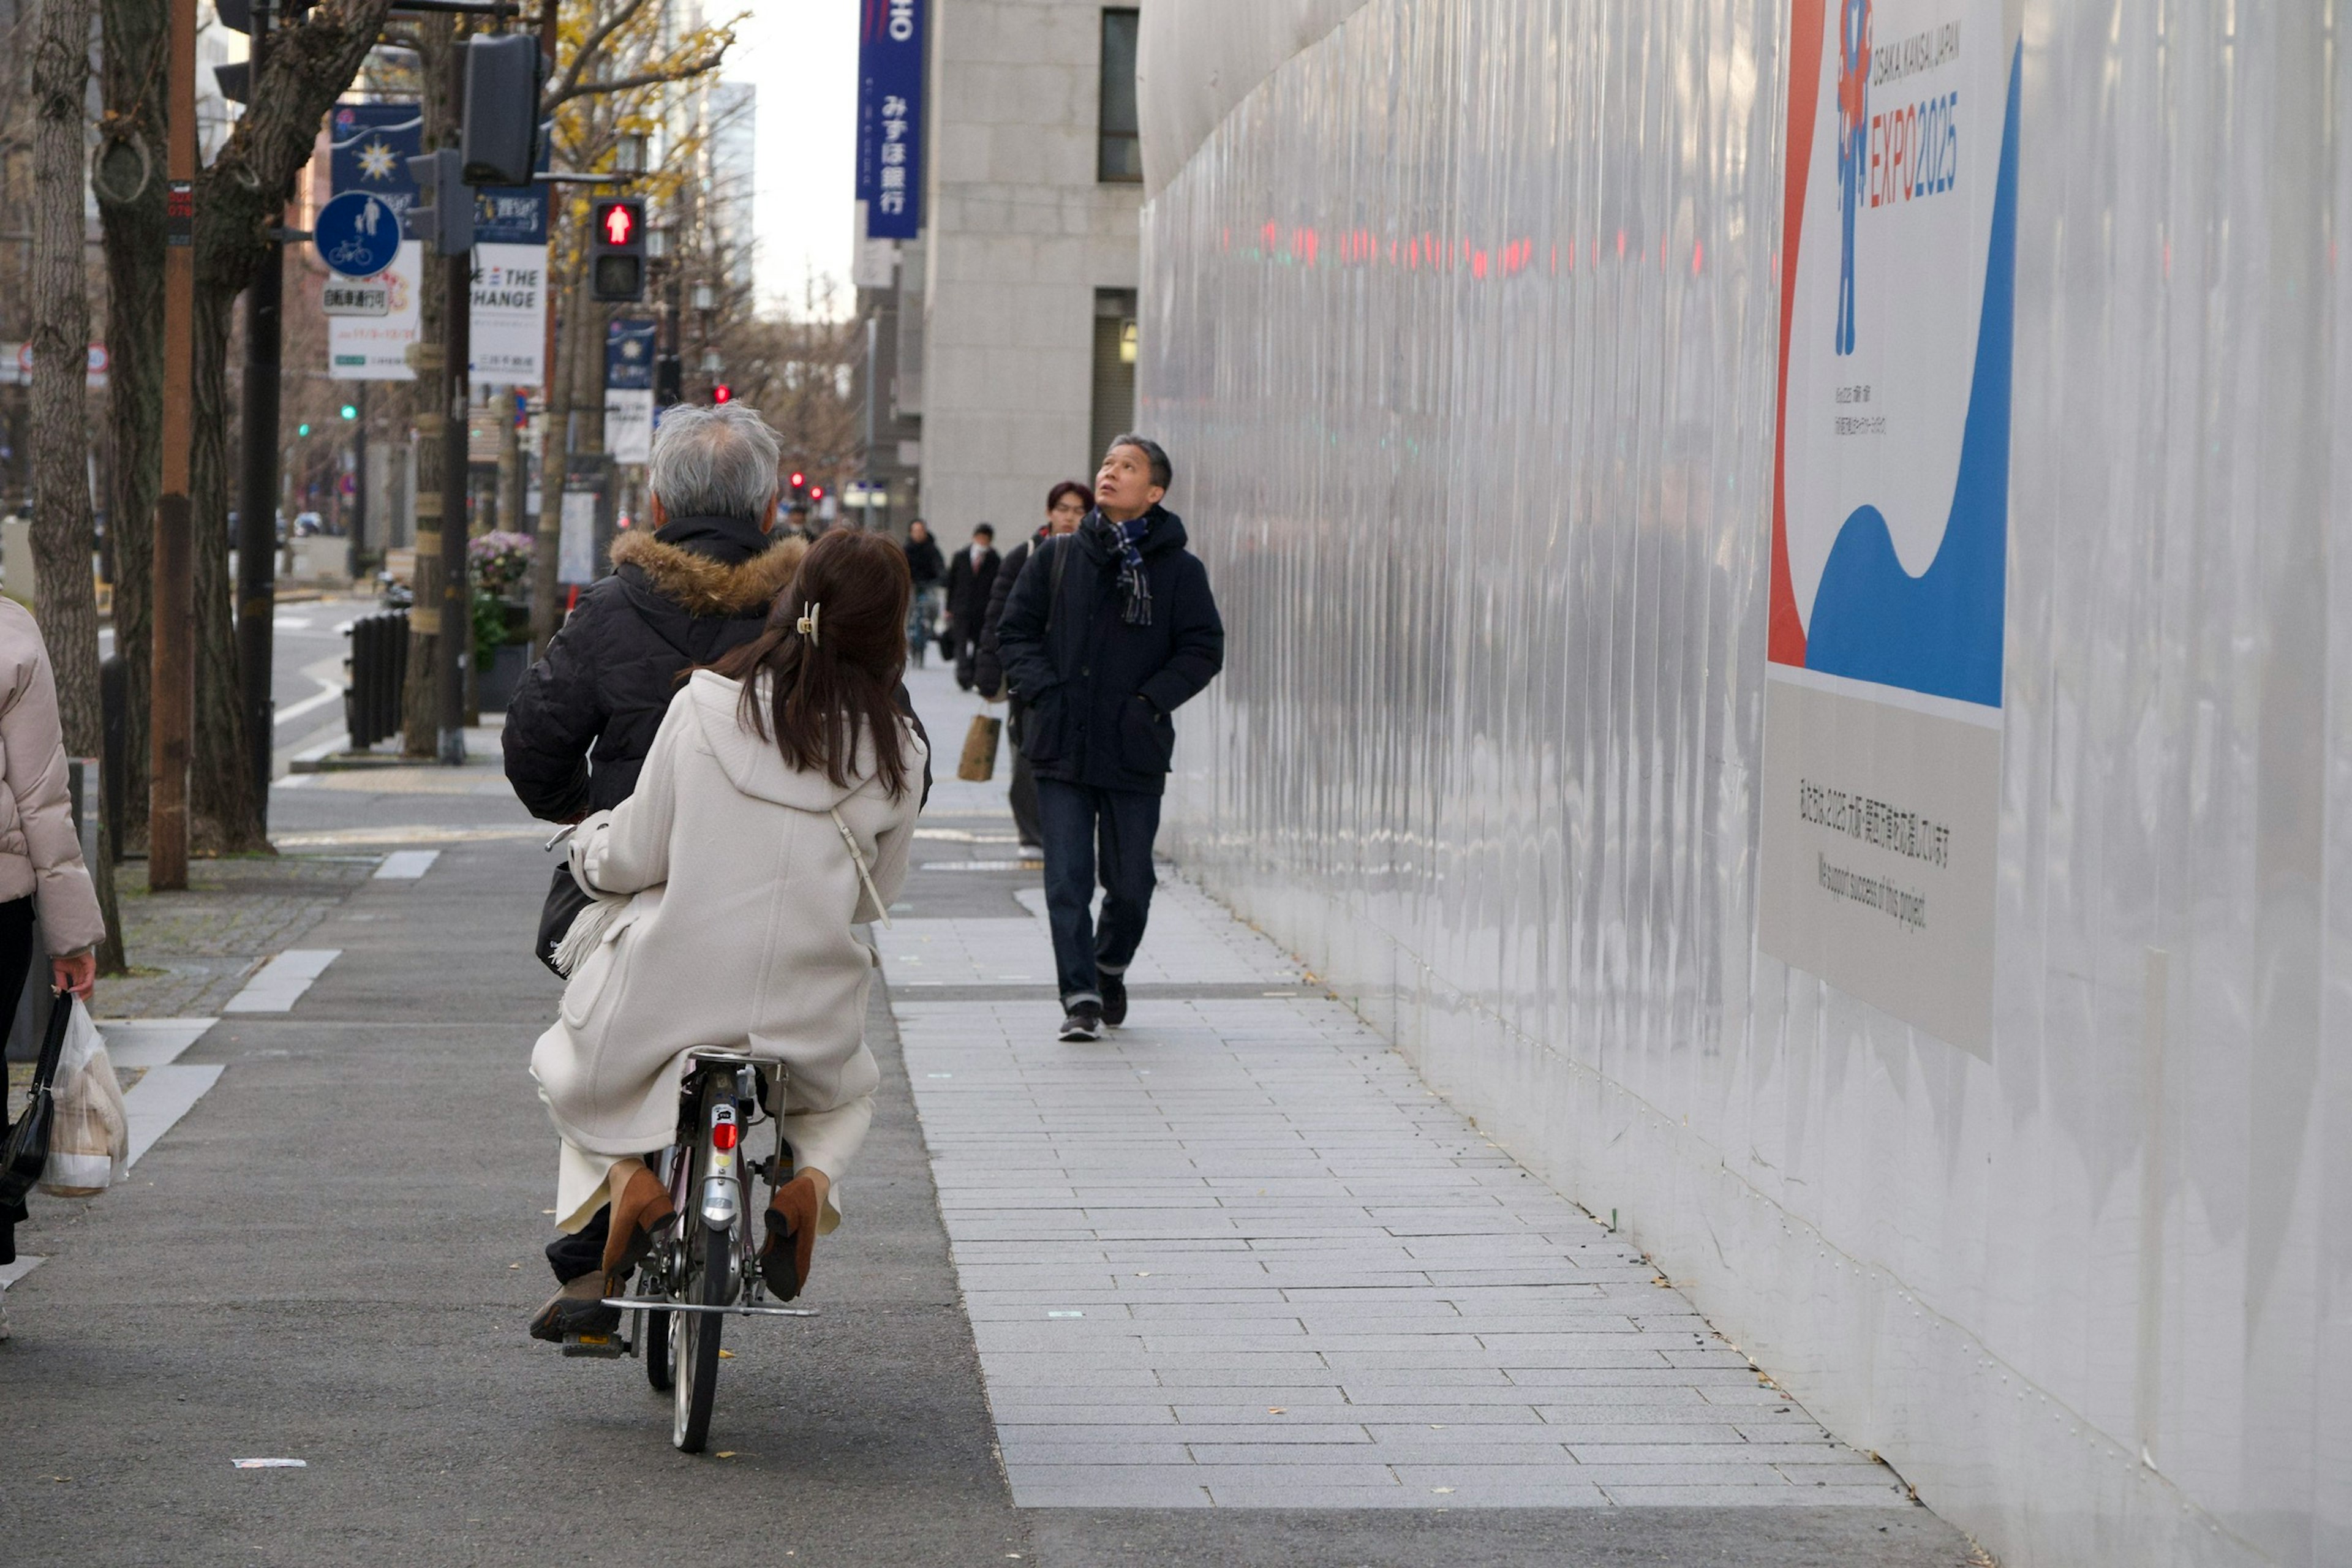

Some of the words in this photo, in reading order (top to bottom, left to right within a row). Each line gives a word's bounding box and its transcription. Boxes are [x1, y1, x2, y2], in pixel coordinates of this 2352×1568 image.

[1935, 19, 1961, 67] JAPAN
[880, 94, 908, 215] みずほ銀行
[506, 268, 539, 287] THE
[324, 289, 385, 309] 自転車通行可
[472, 290, 535, 308] HANGE
